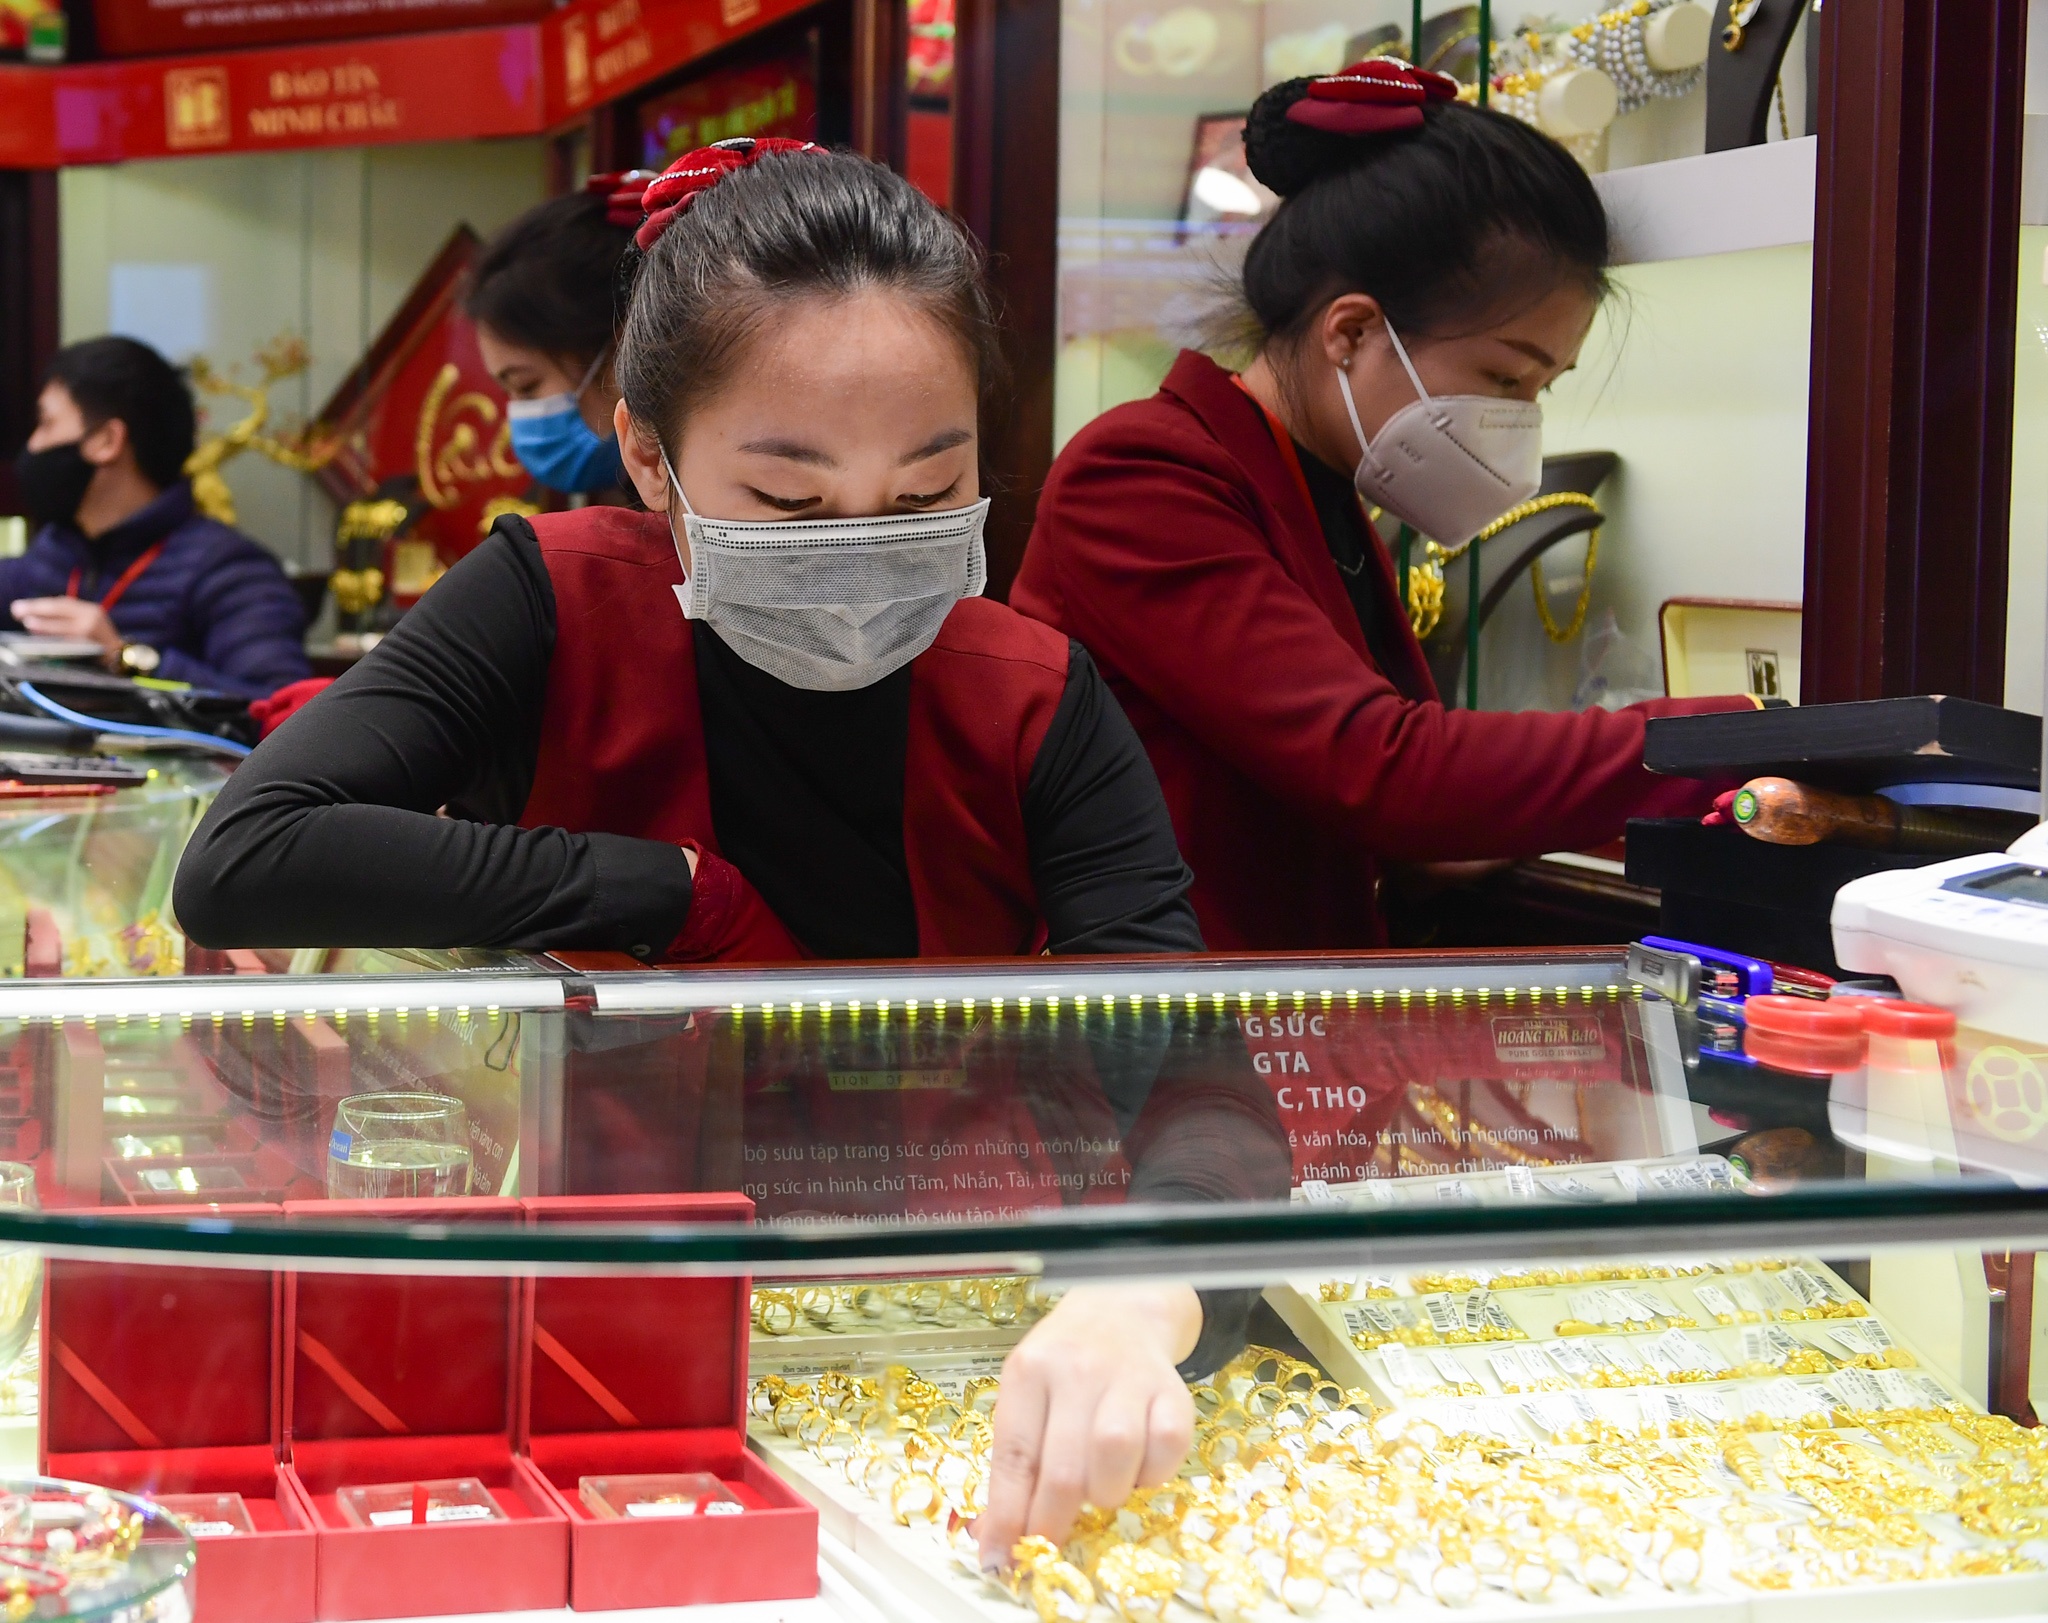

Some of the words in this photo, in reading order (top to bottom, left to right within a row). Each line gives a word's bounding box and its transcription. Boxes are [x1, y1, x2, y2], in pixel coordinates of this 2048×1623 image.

[1544, 1028, 1569, 1044] KIM
[833, 1075, 869, 1087] TION
[744, 1144, 767, 1165] bộ
[773, 1146, 804, 1161] sưu
[810, 1143, 838, 1164] tập
[844, 1143, 890, 1163] trang
[896, 1140, 924, 1158] sức
[931, 1138, 968, 1161] gồm
[974, 1138, 1030, 1160] những
[1302, 1130, 1332, 1147] văn
[1337, 1128, 1372, 1148] hóa,
[1376, 1128, 1407, 1146] tâm
[1477, 1125, 1539, 1145] ngưỡng
[773, 1177, 802, 1195] sức
[807, 1177, 824, 1194] in
[829, 1174, 867, 1194] hình
[873, 1174, 905, 1192] chữ
[907, 1173, 949, 1192] Tâm,
[953, 1170, 1003, 1191] Nhẫn,
[1005, 1170, 1035, 1190] Tài,
[1039, 1172, 1084, 1191] trang
[1089, 1169, 1117, 1187] sức
[1303, 1161, 1351, 1180] thánh
